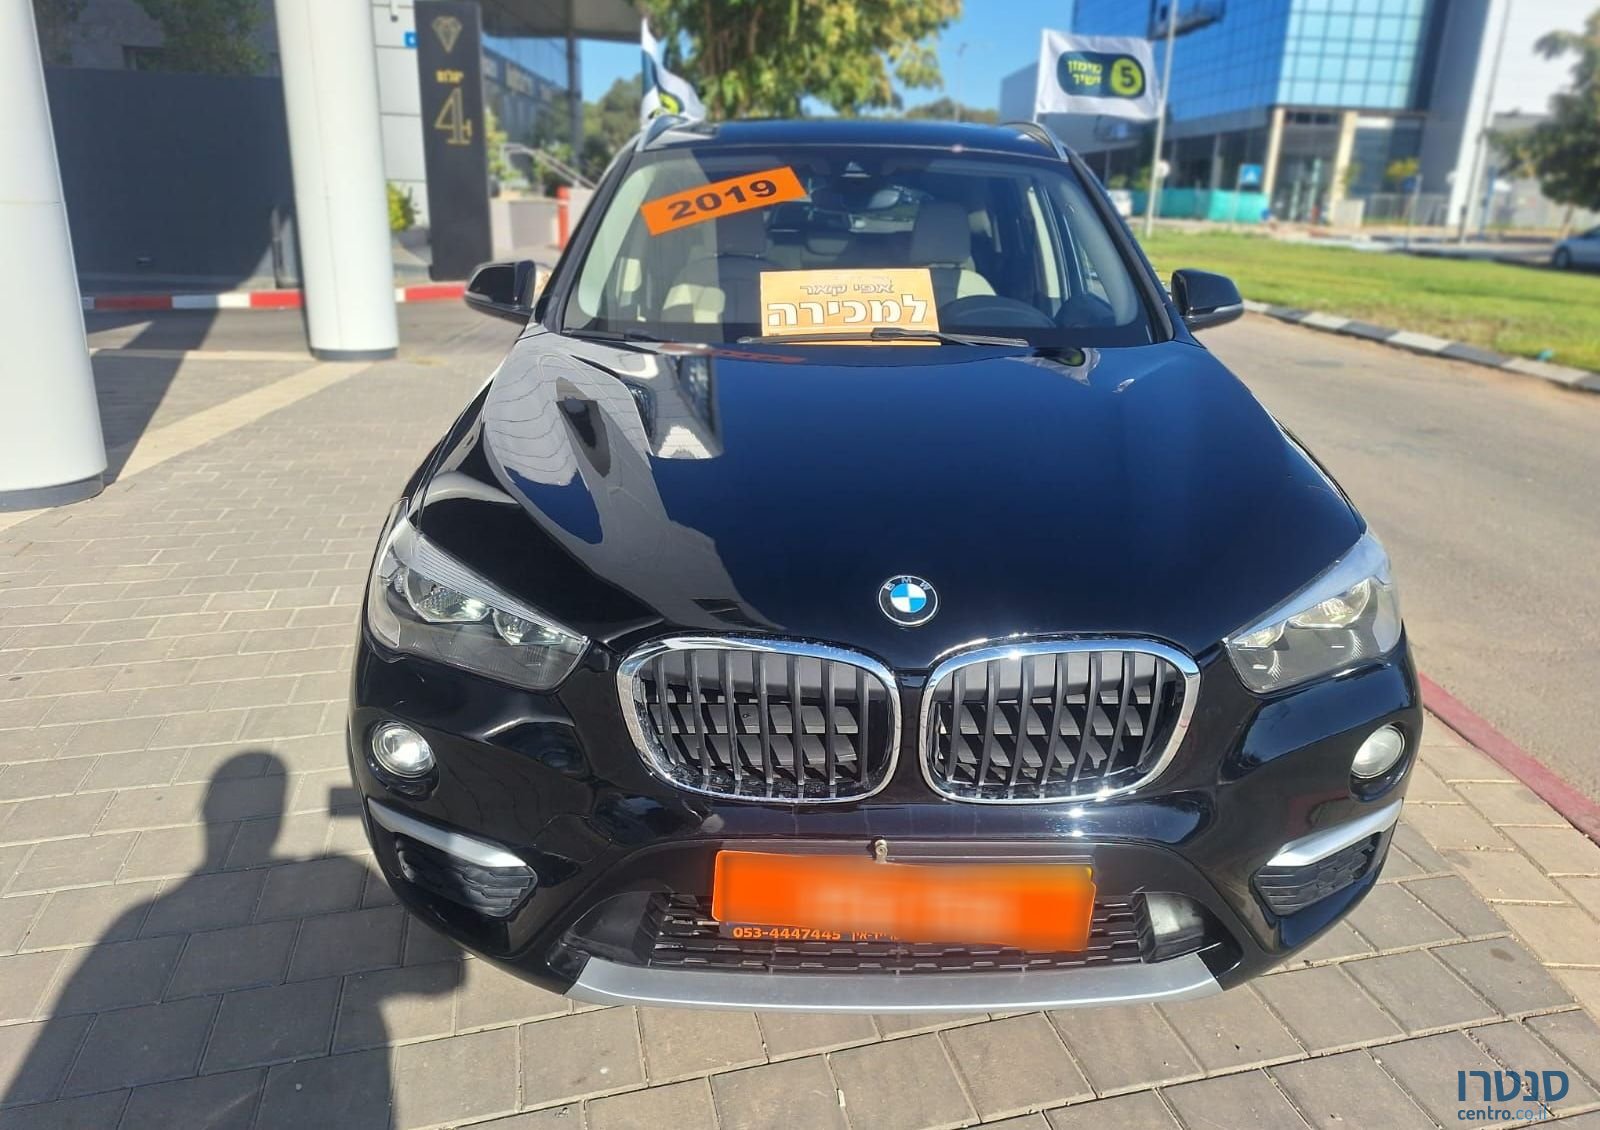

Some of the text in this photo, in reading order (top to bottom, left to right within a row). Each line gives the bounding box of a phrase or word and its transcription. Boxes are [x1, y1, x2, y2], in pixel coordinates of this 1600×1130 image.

[1121, 66, 1136, 87] 5
[667, 180, 777, 221] 2019
[767, 294, 928, 326] למכירה
[884, 577, 931, 590] BMW
[733, 927, 841, 941] 053-4447445
